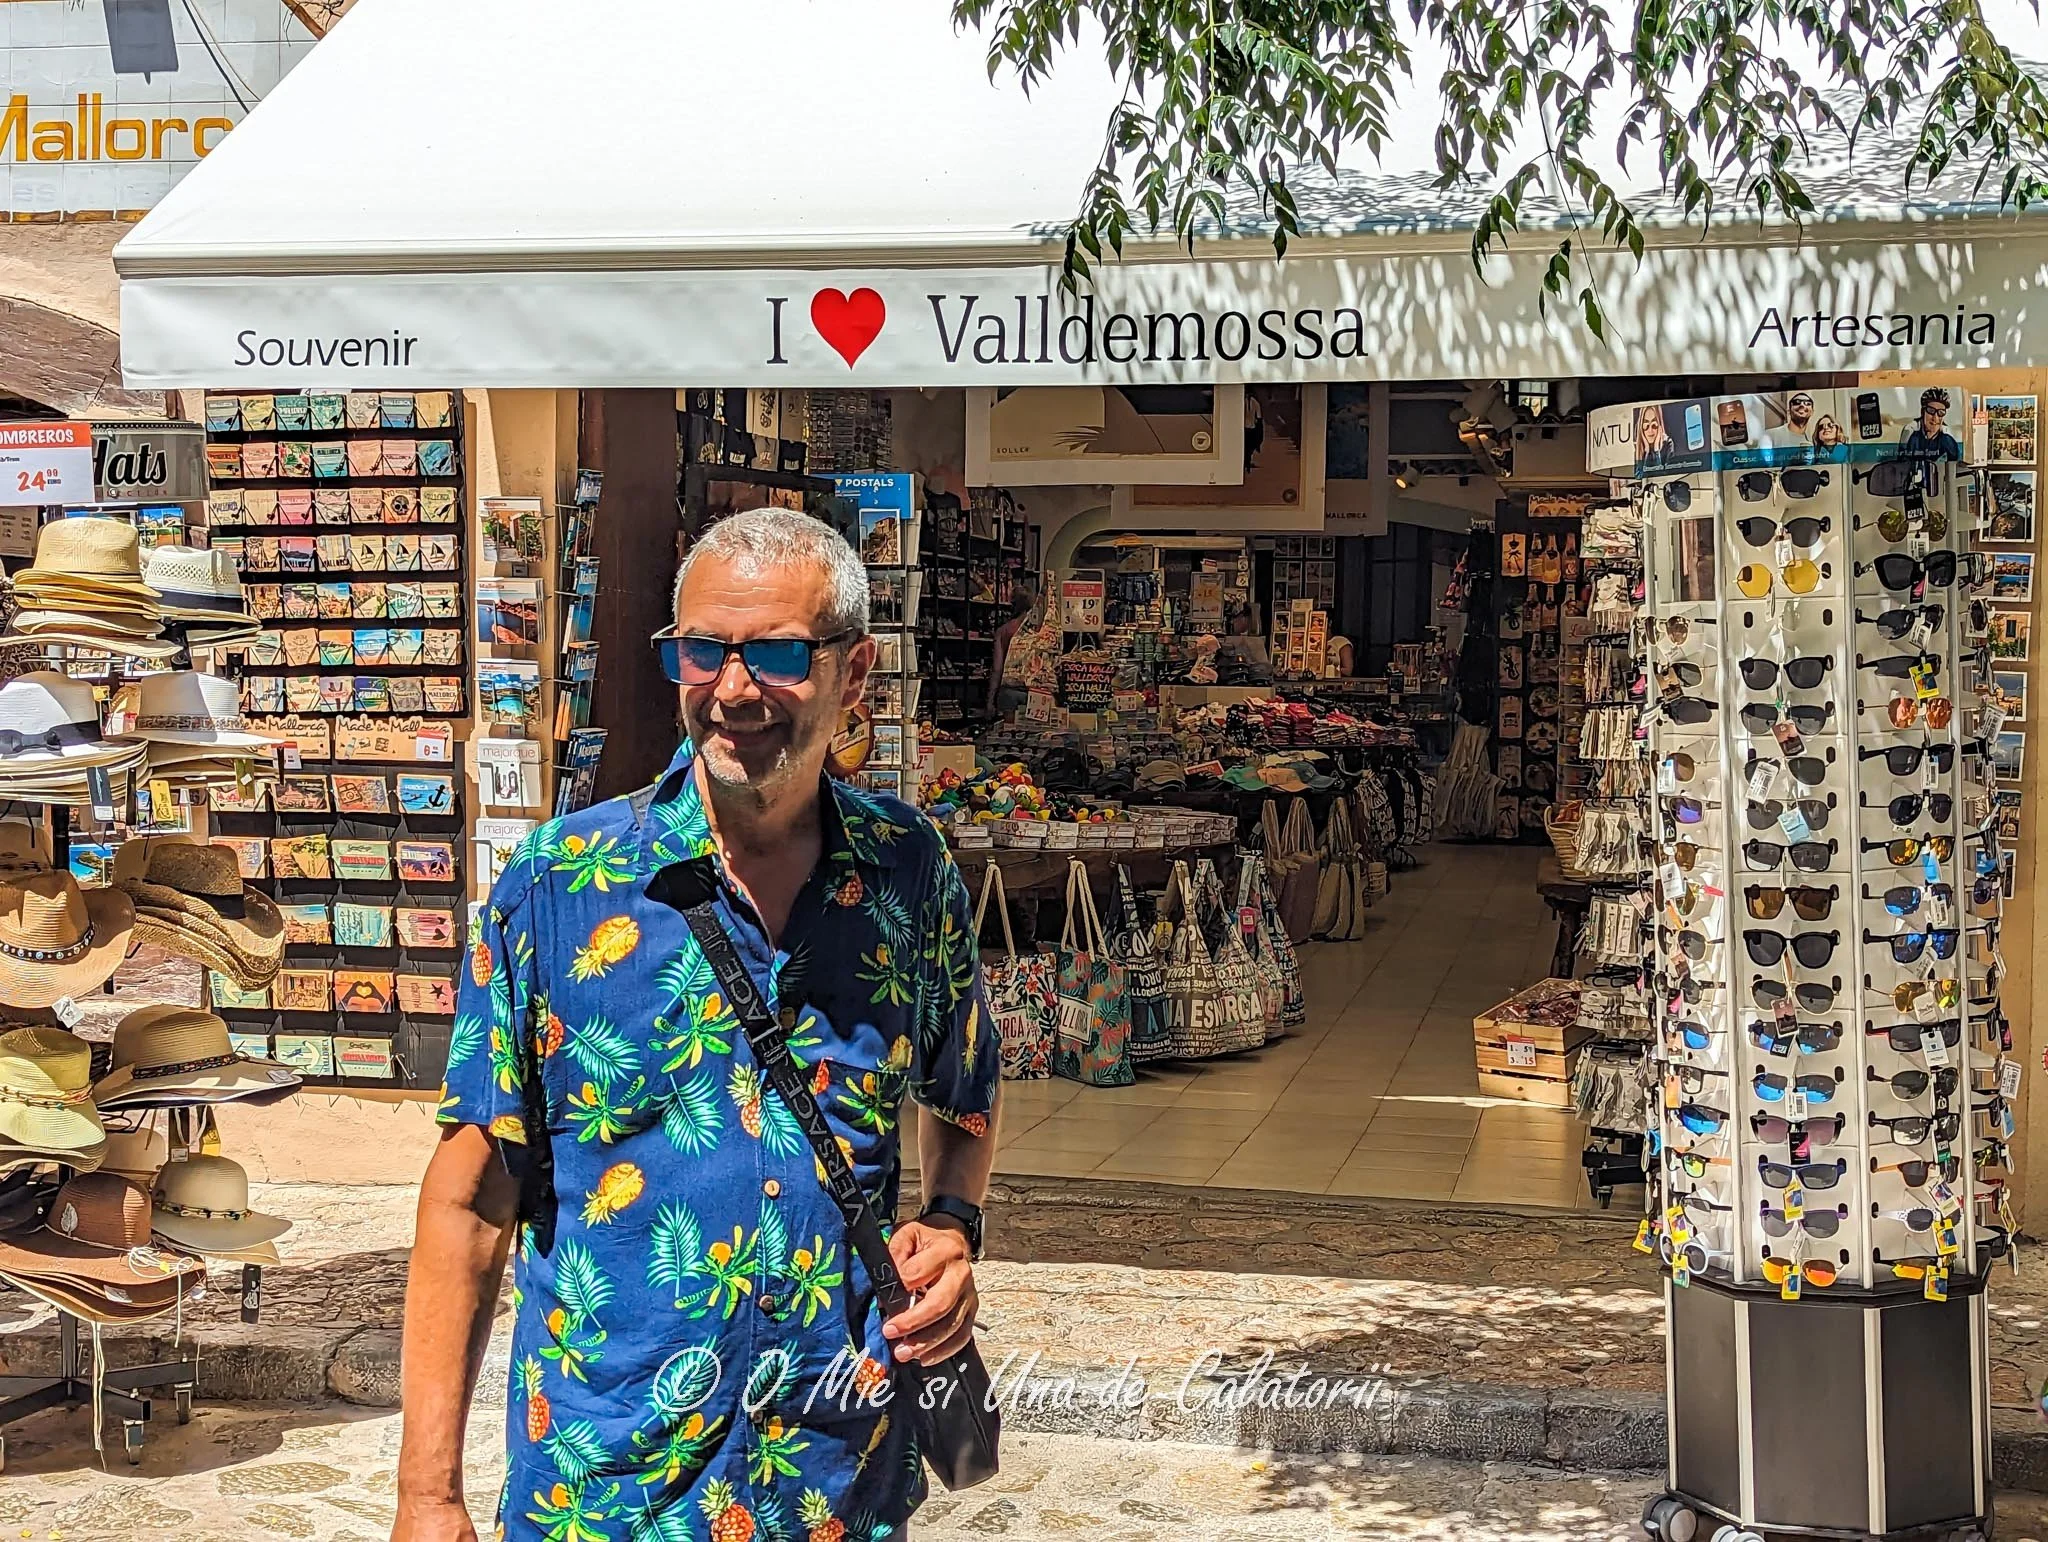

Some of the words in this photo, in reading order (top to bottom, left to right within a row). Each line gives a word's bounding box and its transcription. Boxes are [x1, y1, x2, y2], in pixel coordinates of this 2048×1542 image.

[766, 297, 789, 365] I
[926, 293, 1369, 366] Valldemossa
[1748, 304, 1996, 349] Artesania
[234, 329, 418, 367] Souvenir
[0, 428, 74, 445] MBREROS
[1592, 422, 1631, 448] NATU
[17, 471, 46, 492] 24
[845, 478, 894, 487] POSTALS
[268, 718, 326, 731] Mallorca
[338, 716, 373, 732] Made
[483, 746, 536, 759] majorque
[783, 1071, 865, 1227] VERSACE
